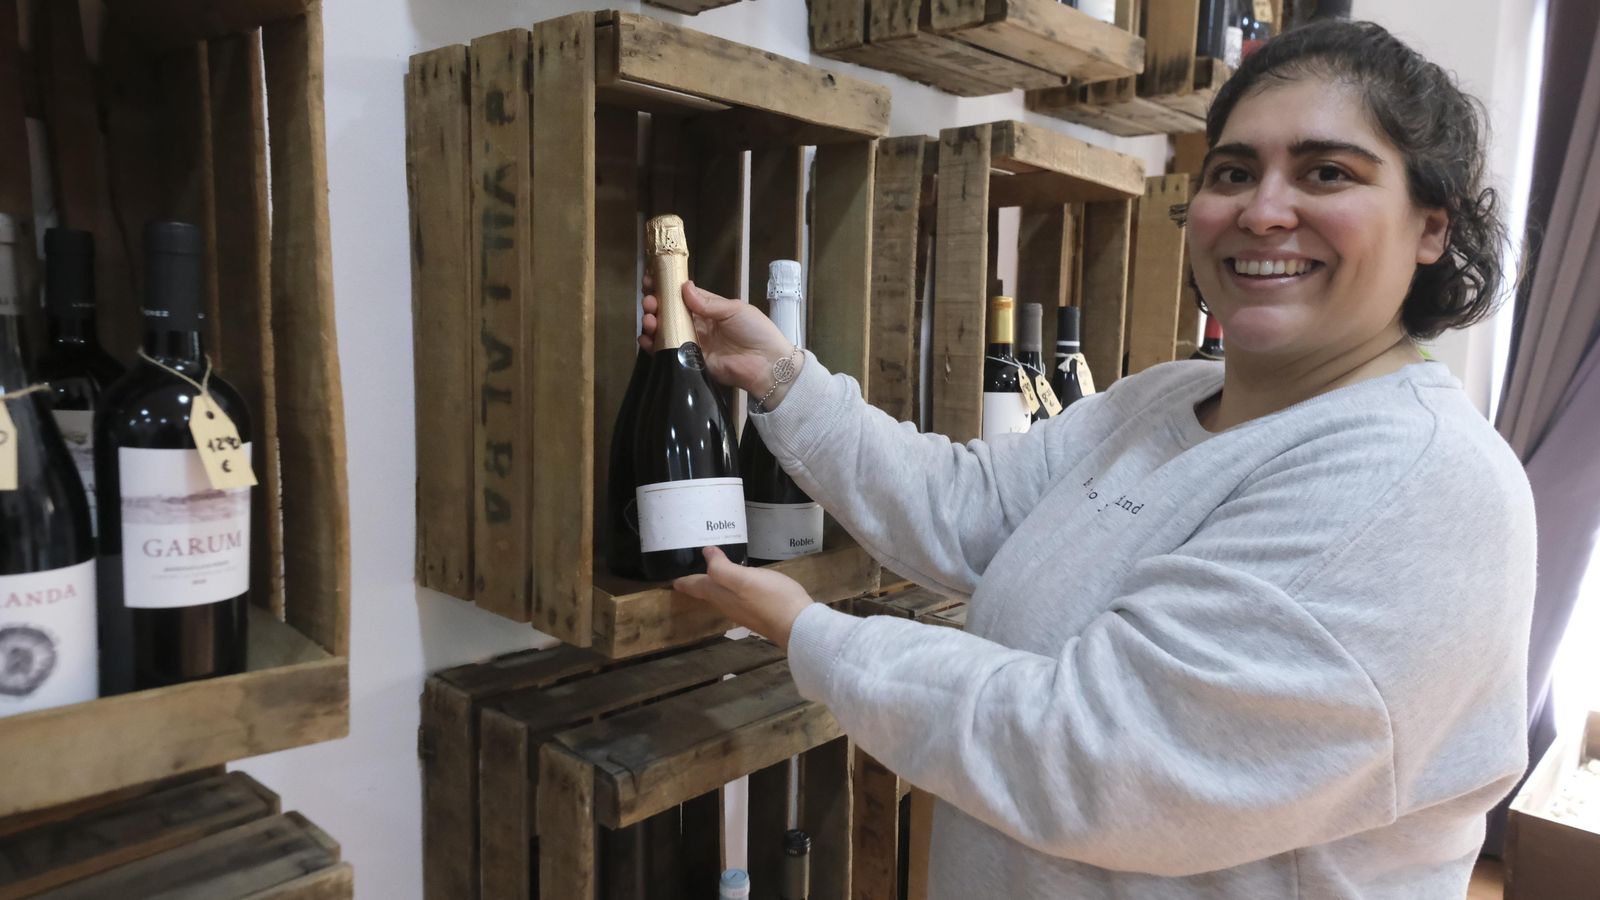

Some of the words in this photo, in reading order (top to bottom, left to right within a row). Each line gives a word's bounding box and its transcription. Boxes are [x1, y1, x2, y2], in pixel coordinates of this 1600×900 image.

[706, 519, 736, 532] Robles
[142, 530, 243, 558] GARUM
[789, 536, 815, 548] Robles
[0, 583, 78, 608] ANDA
